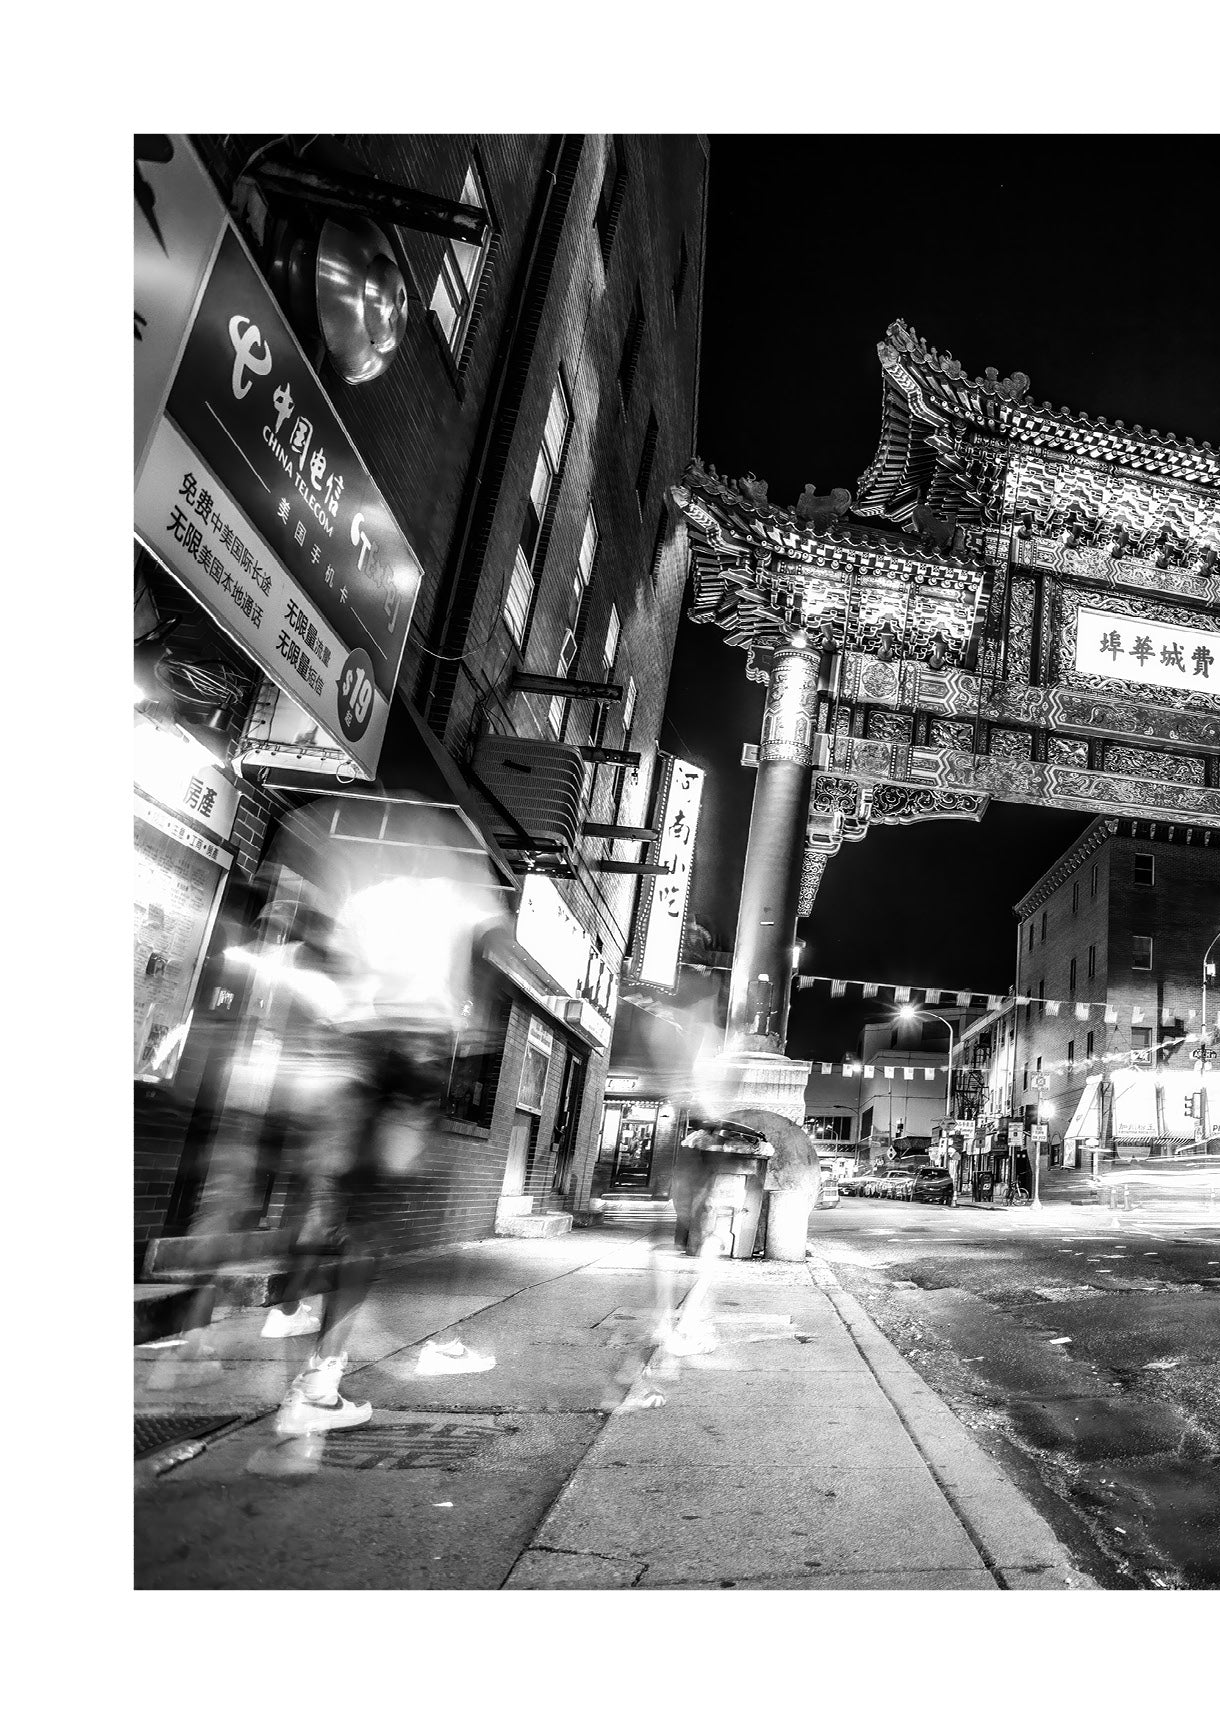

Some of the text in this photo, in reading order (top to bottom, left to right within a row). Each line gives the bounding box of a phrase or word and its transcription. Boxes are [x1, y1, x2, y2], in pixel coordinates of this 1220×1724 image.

[262, 425, 335, 538] CHINA TELECOM
[274, 382, 345, 518] 中国电信
[166, 505, 325, 698] 无限美国本地通话 无限量短信
[178, 472, 332, 669] 免费中美国际长途 无限量流量
[342, 667, 373, 724] $19
